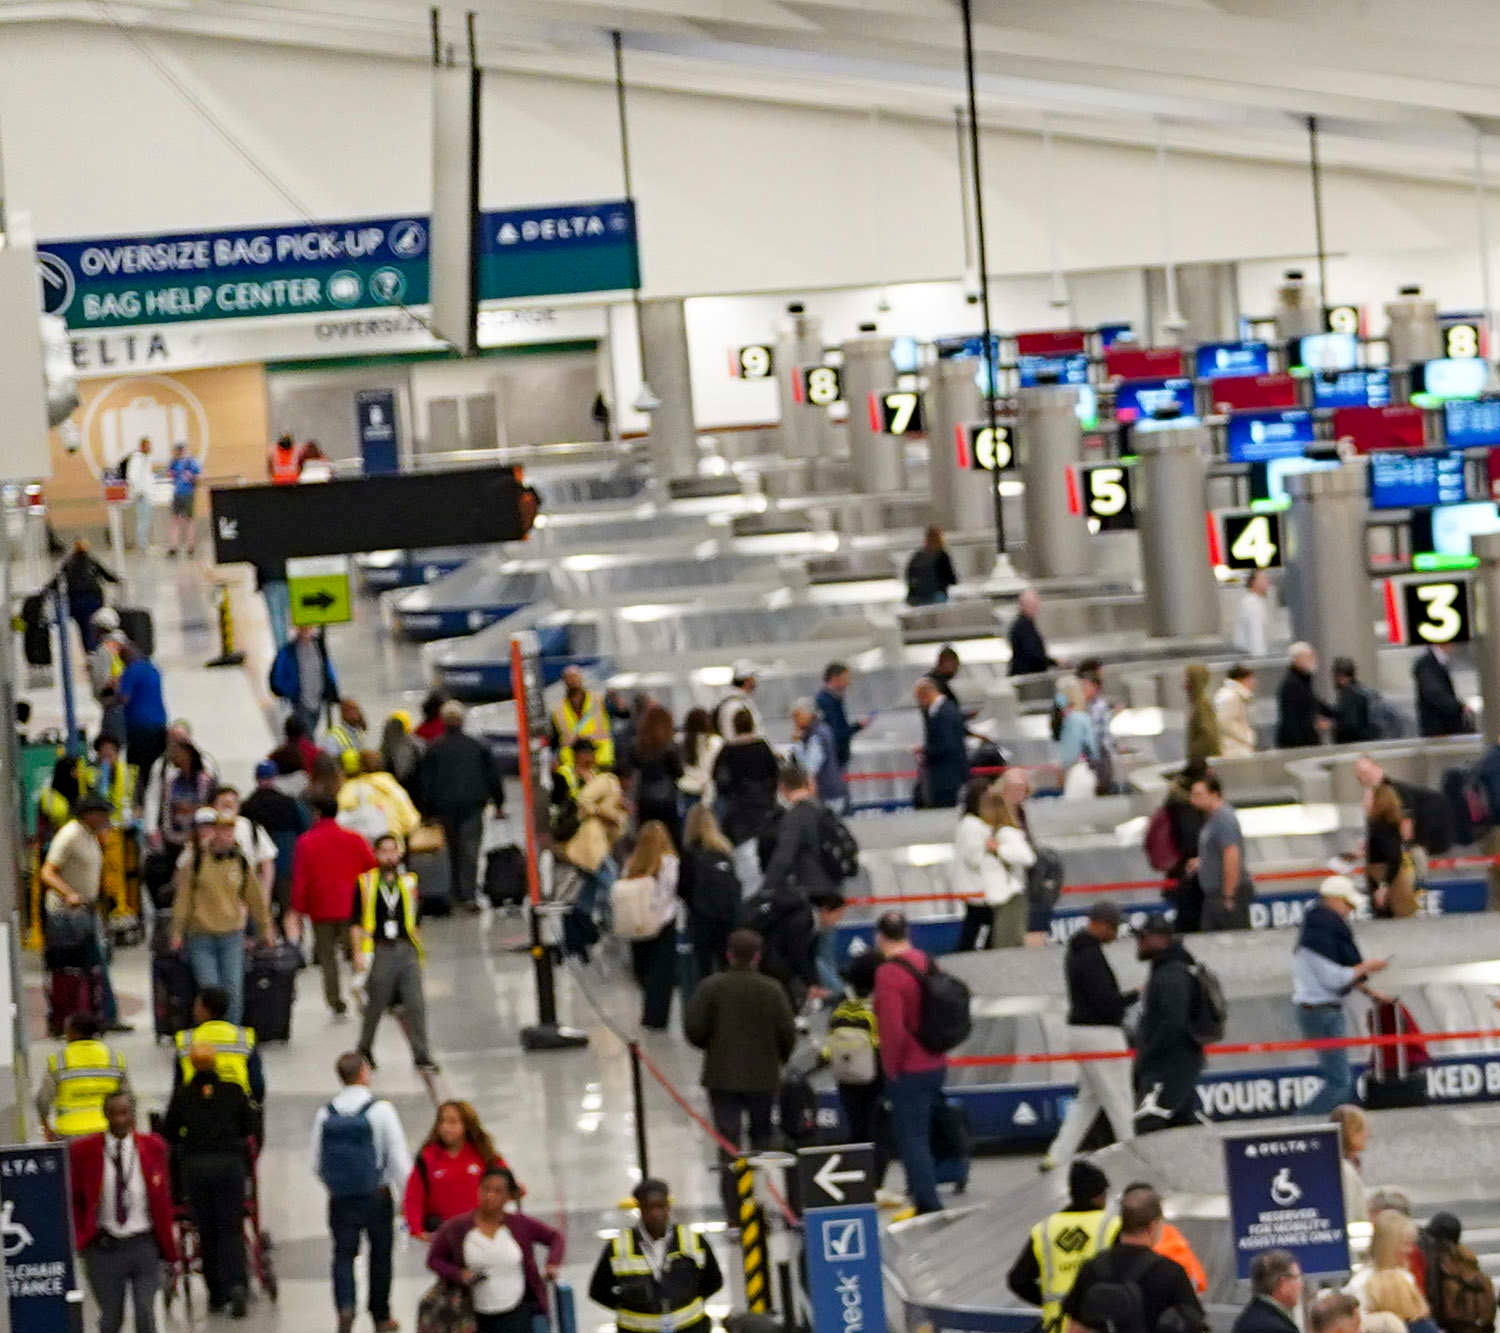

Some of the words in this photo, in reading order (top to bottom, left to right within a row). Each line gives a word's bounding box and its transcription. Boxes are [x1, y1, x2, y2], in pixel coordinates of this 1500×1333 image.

[521, 215, 606, 241] DELTA
[79, 240, 210, 276] OVERSIZE
[213, 236, 272, 267] BAG
[276, 228, 384, 262] PICK-UP
[83, 290, 142, 321] BAG
[145, 285, 213, 316] HELP
[215, 278, 321, 311] CENTER
[1330, 309, 1358, 335] 9
[70, 332, 169, 369] ELTA
[1448, 325, 1477, 358] 8
[740, 347, 771, 378] 9
[809, 368, 840, 404] 8
[885, 394, 919, 433] 7
[976, 428, 1011, 470] 6
[1090, 470, 1127, 516] 5
[1231, 517, 1276, 567] 4
[1418, 584, 1460, 643] 3
[1197, 1079, 1275, 1116] YOUR
[1, 1158, 39, 1177] LTA
